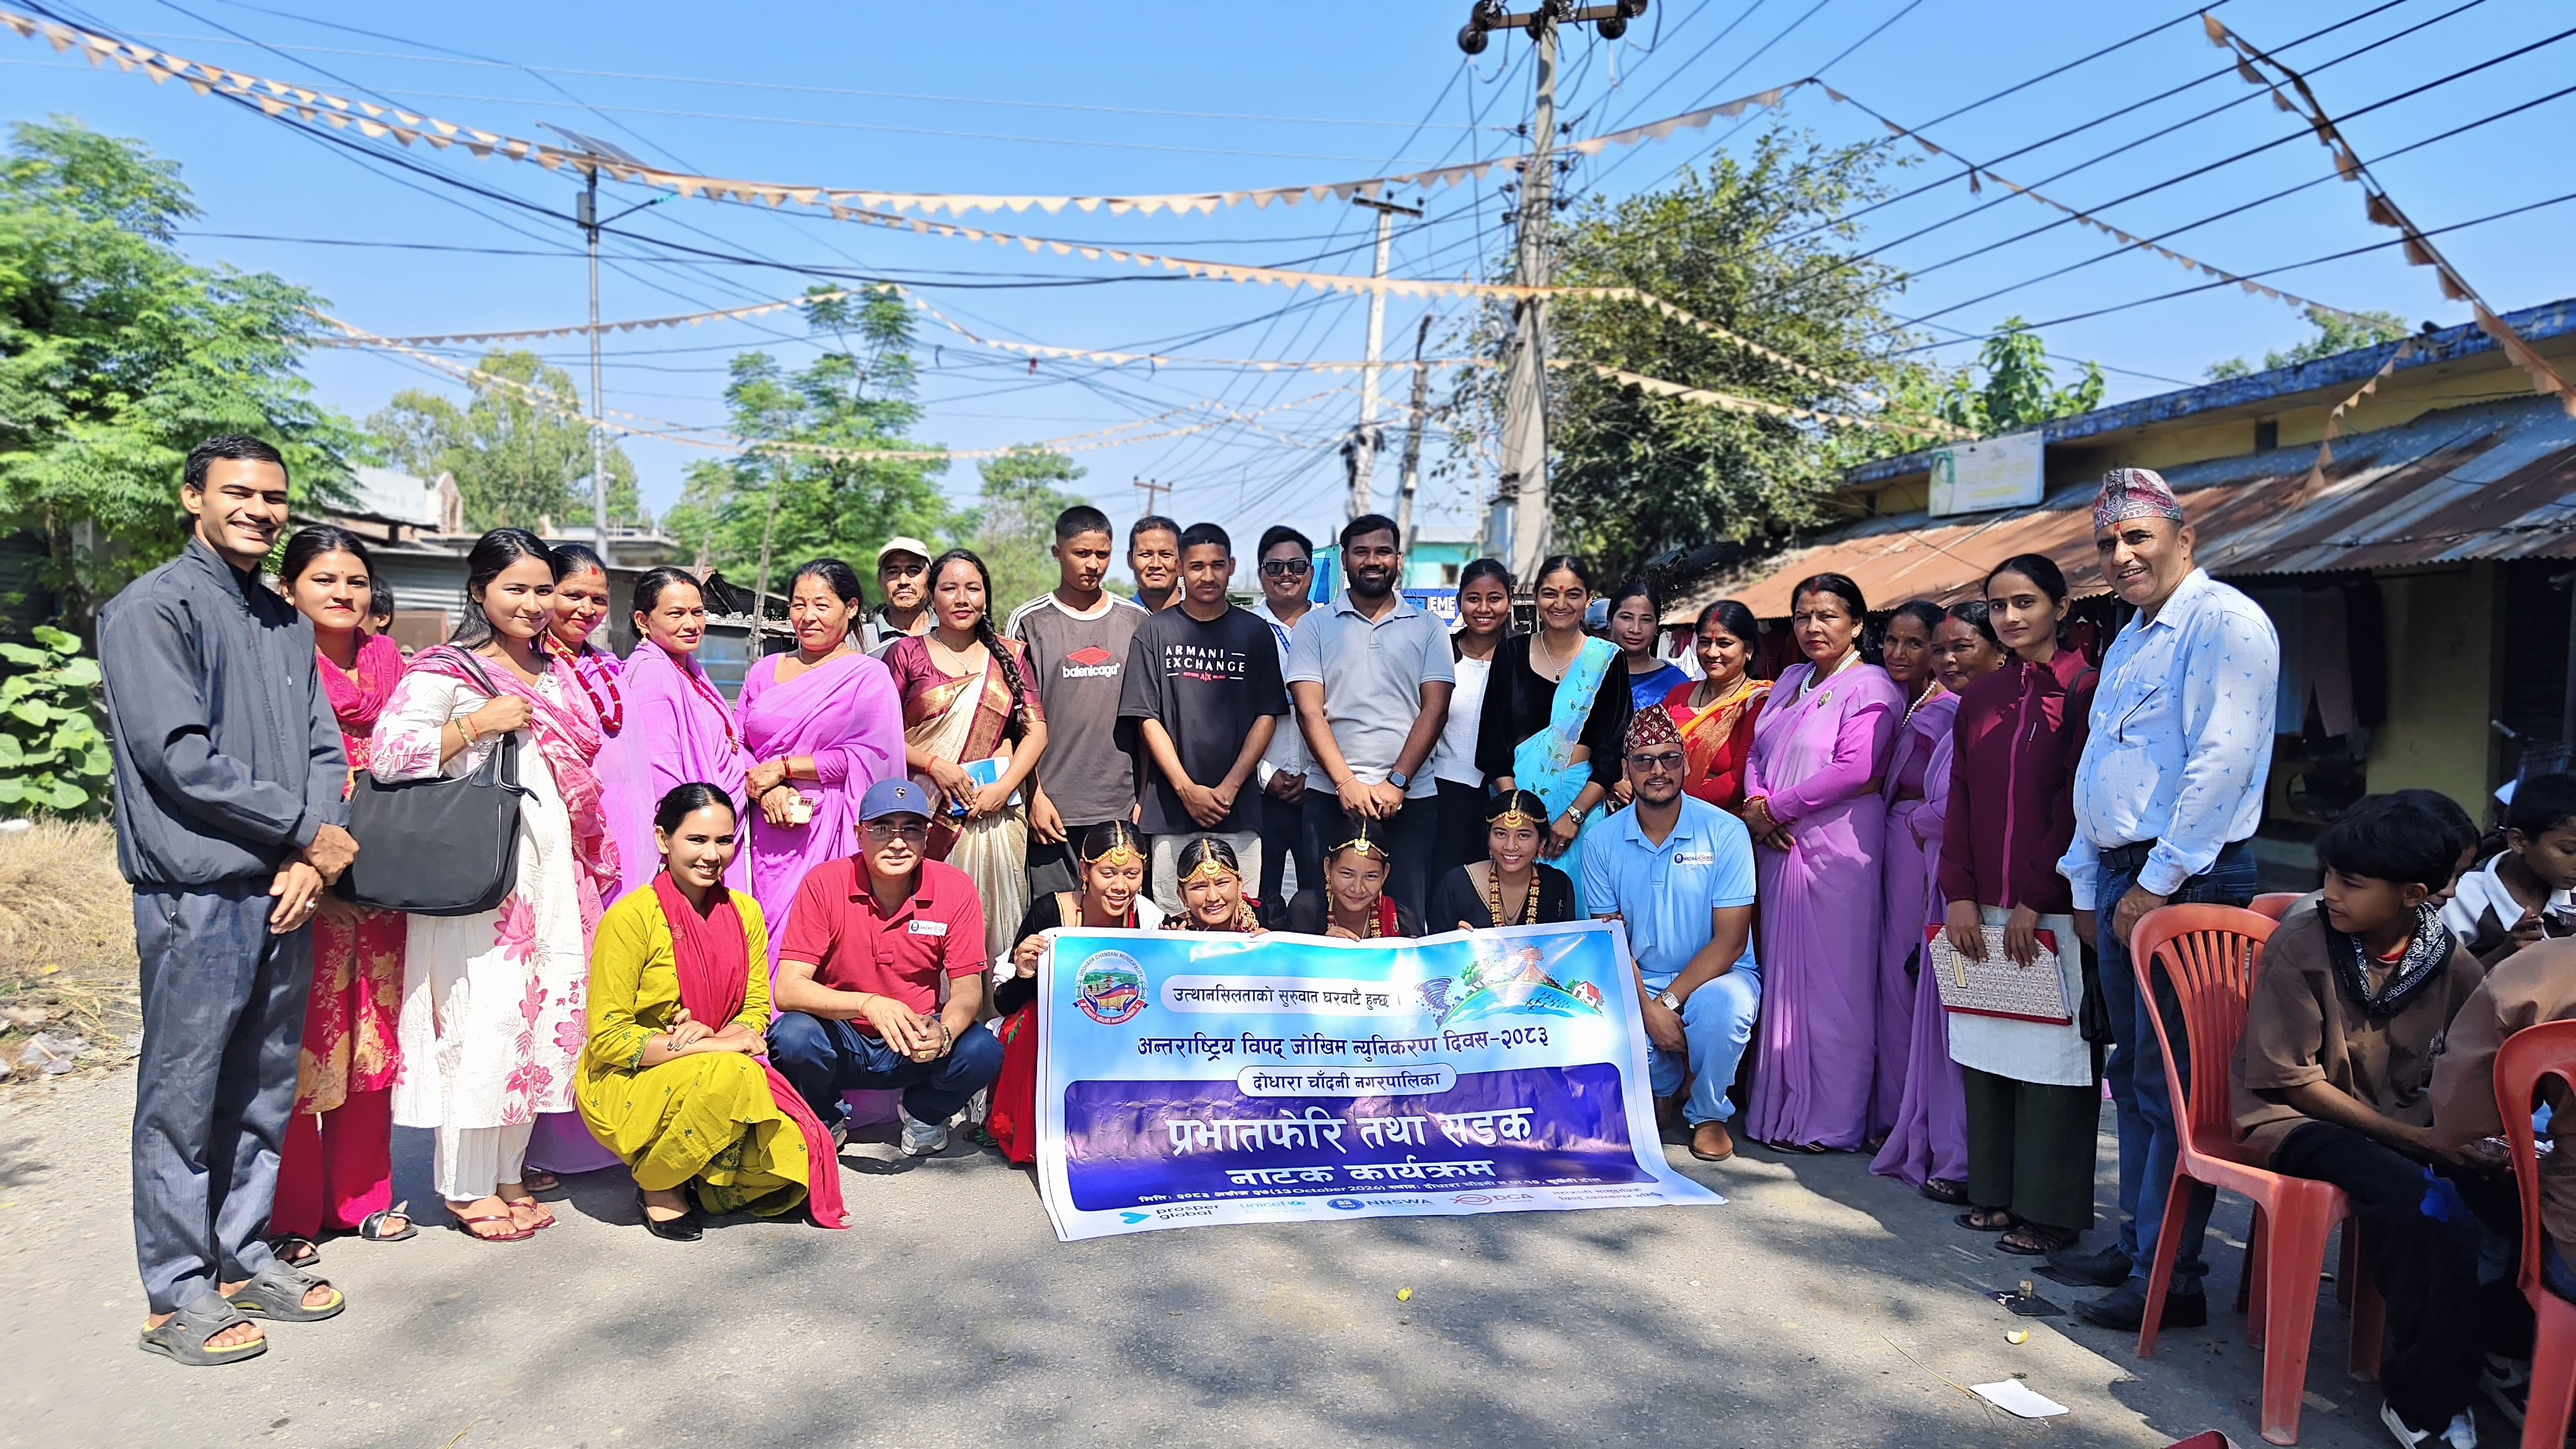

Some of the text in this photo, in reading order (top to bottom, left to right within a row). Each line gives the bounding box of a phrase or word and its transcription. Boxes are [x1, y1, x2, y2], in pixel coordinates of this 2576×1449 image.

[1428, 596, 1457, 611] EME
[1165, 645, 1224, 658] ARMANI
[1165, 657, 1245, 672] EXCHANGE
[1079, 952, 1144, 977] DODHARA CHANDANI MUNICIPALITY
[1241, 1032, 1287, 1060] विपद्
[1290, 1032, 1347, 1055] जोखिम
[1352, 1034, 1438, 1062] न्युनिकरण
[1253, 1070, 1441, 1091] दोधारा चाँदनी नगरपालिका
[1164, 1106, 1534, 1156] प्रभातफेरि तथा सडक
[1226, 1155, 1496, 1186] नाटक कार्यक्रम
[1156, 1204, 1220, 1215] prosper
[1240, 1200, 1285, 1208] unicef
[1159, 1209, 1213, 1220] global
